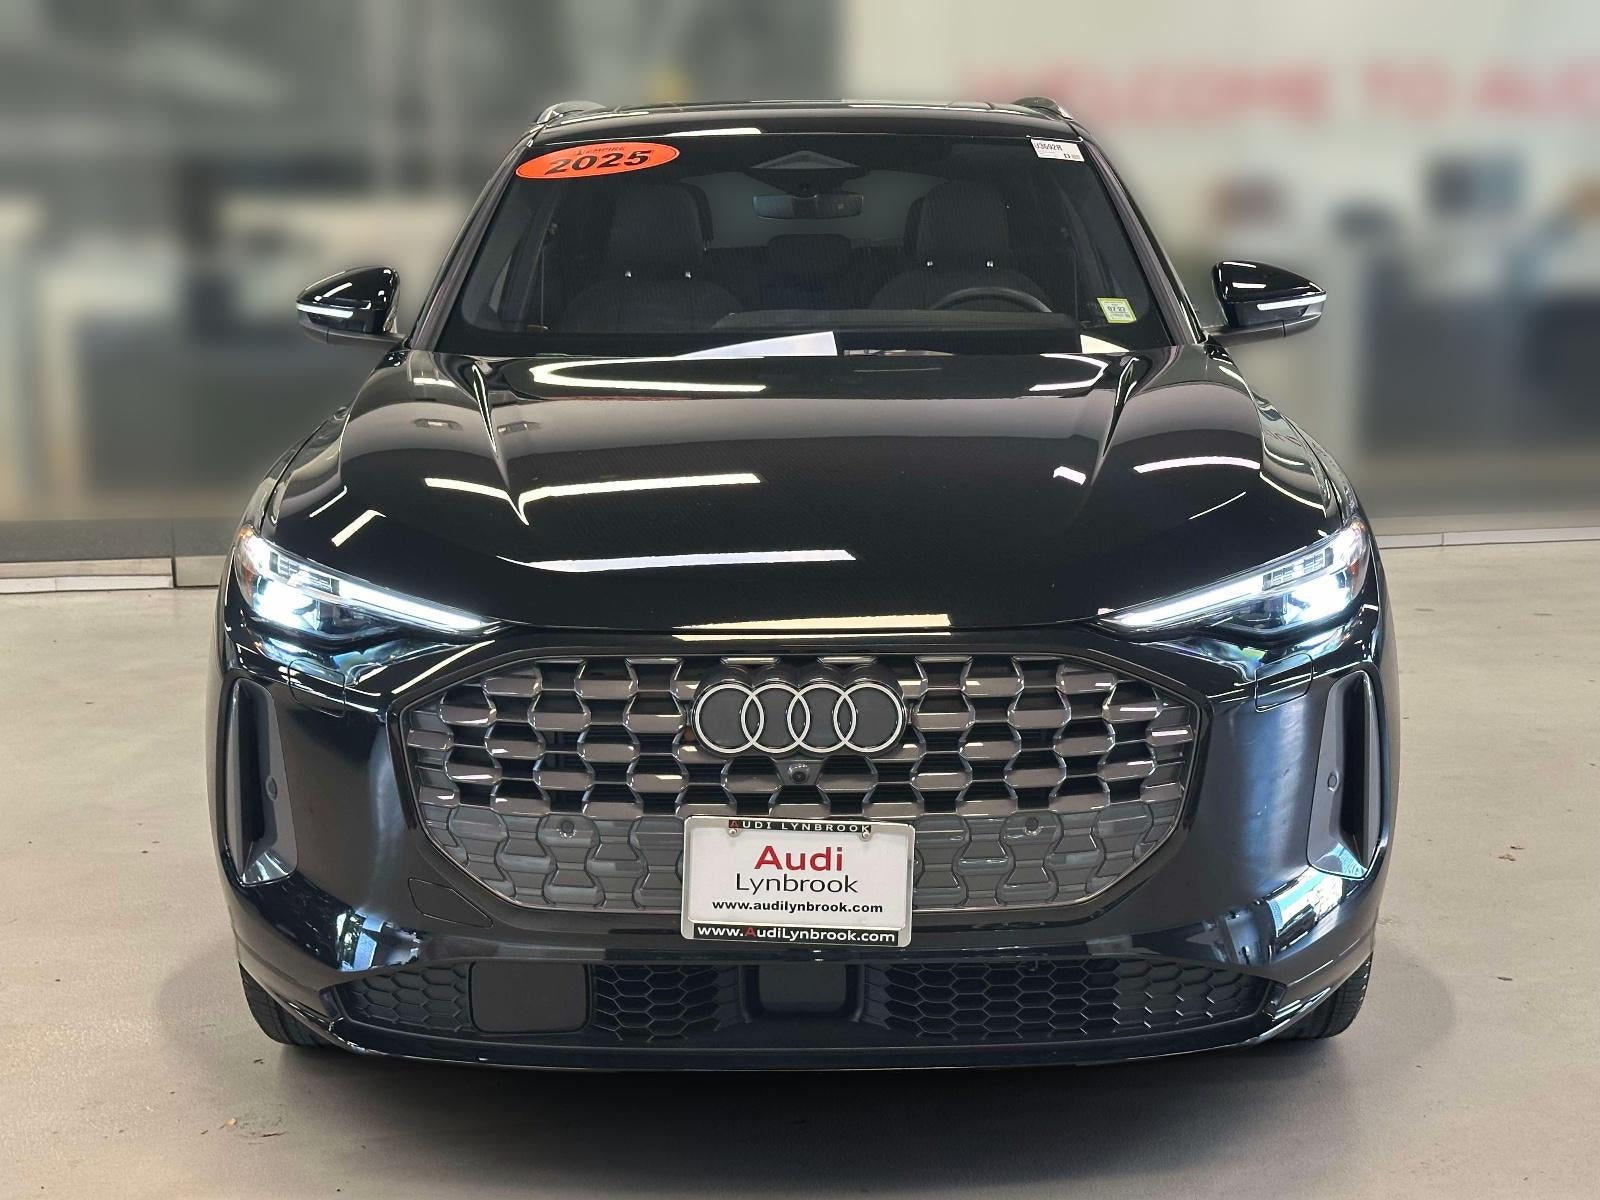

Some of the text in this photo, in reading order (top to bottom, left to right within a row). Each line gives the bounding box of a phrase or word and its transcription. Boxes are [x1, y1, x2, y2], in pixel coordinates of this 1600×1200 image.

[544, 150, 654, 176] 2025
[730, 819, 870, 833] AUDI LYNBROOK
[754, 845, 844, 872] Audi
[736, 873, 859, 895] Lynbrook
[712, 900, 884, 914] www.audilynbrook.com
[697, 926, 896, 943] www.AudiLynbrook.com
